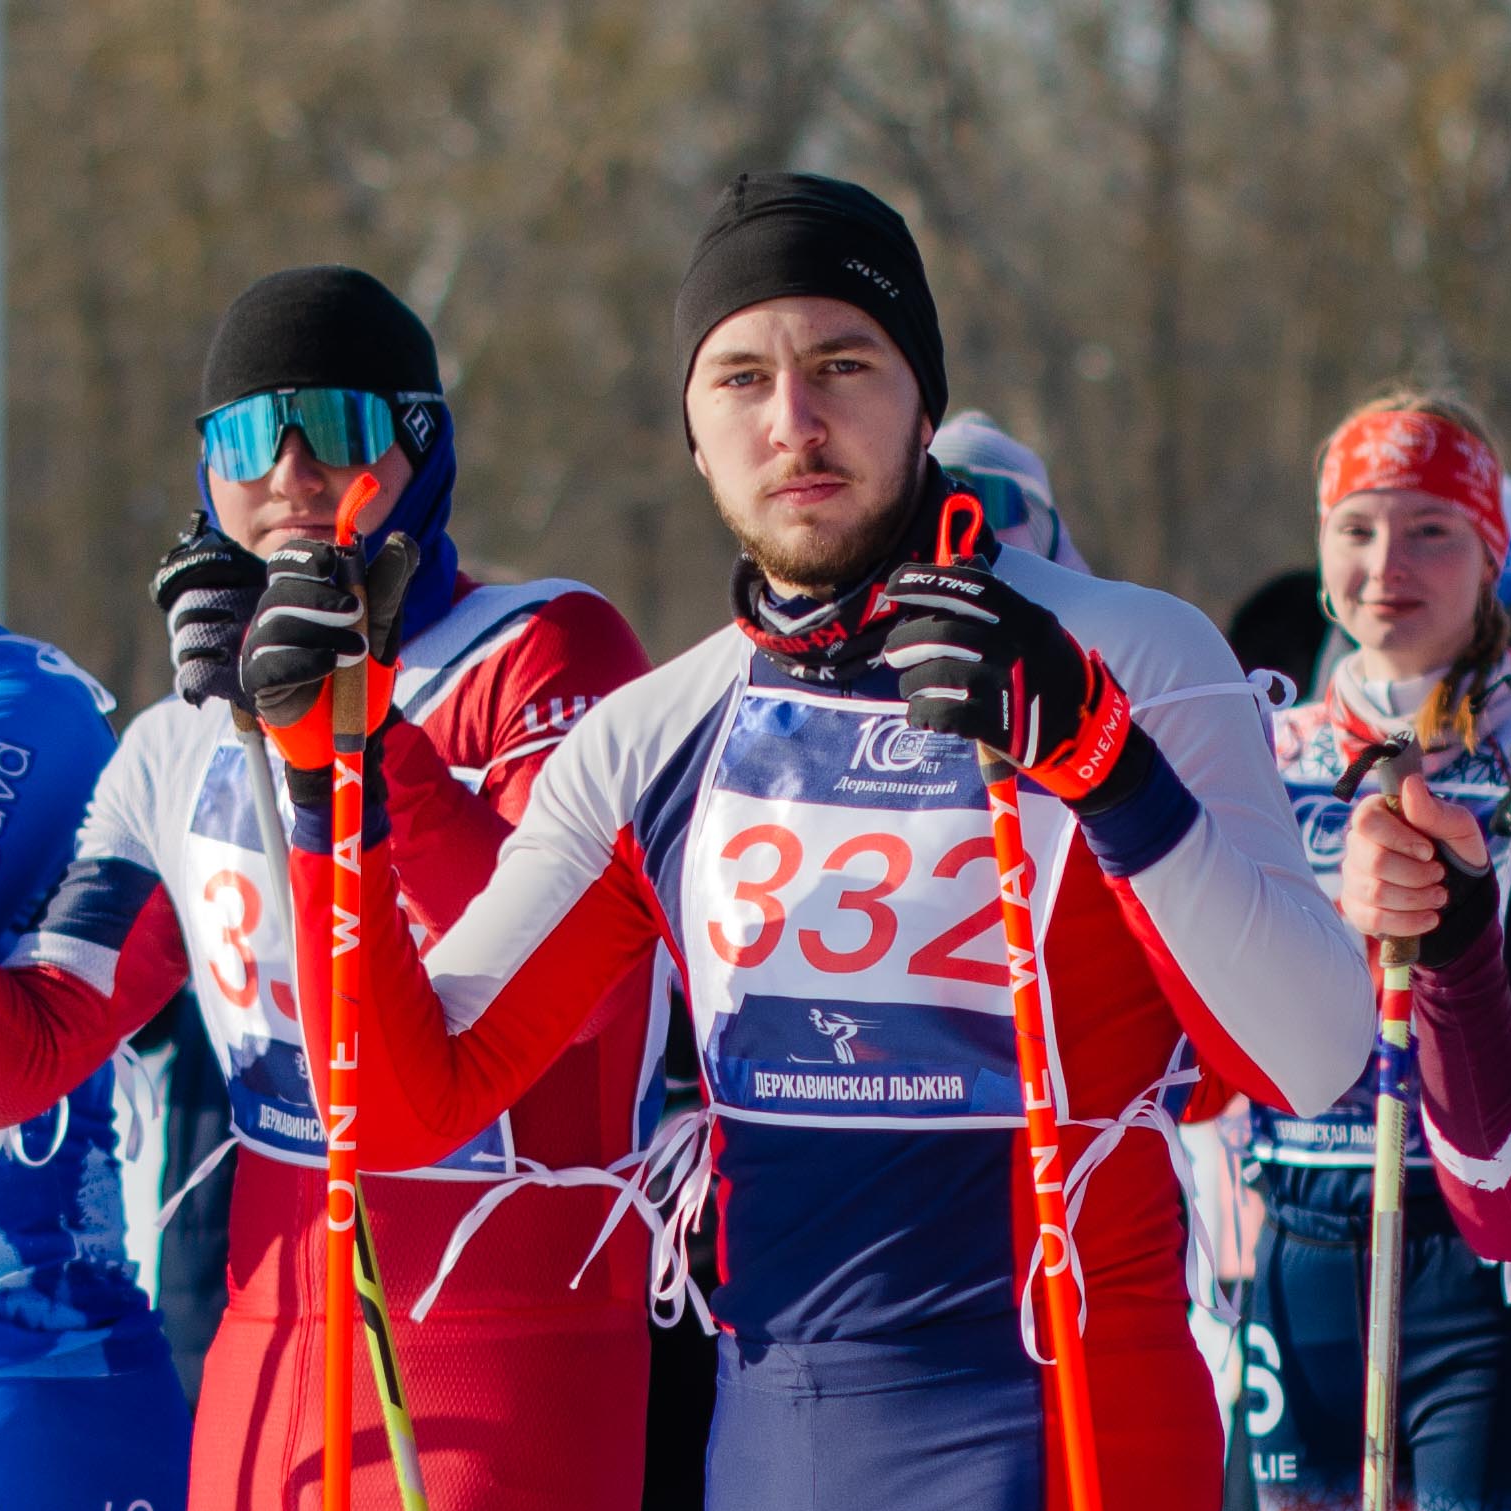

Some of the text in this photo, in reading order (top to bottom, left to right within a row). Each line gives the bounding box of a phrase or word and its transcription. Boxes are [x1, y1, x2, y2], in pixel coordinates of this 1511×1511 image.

[899, 573, 986, 596] SKI TIME
[1077, 692, 1125, 780] ONE/WAY
[833, 775, 959, 797] Державинский
[707, 822, 1038, 988] 332
[754, 1072, 966, 1102] ДЕРЖАВИНСКАЯ ЛЫЖНЯ
